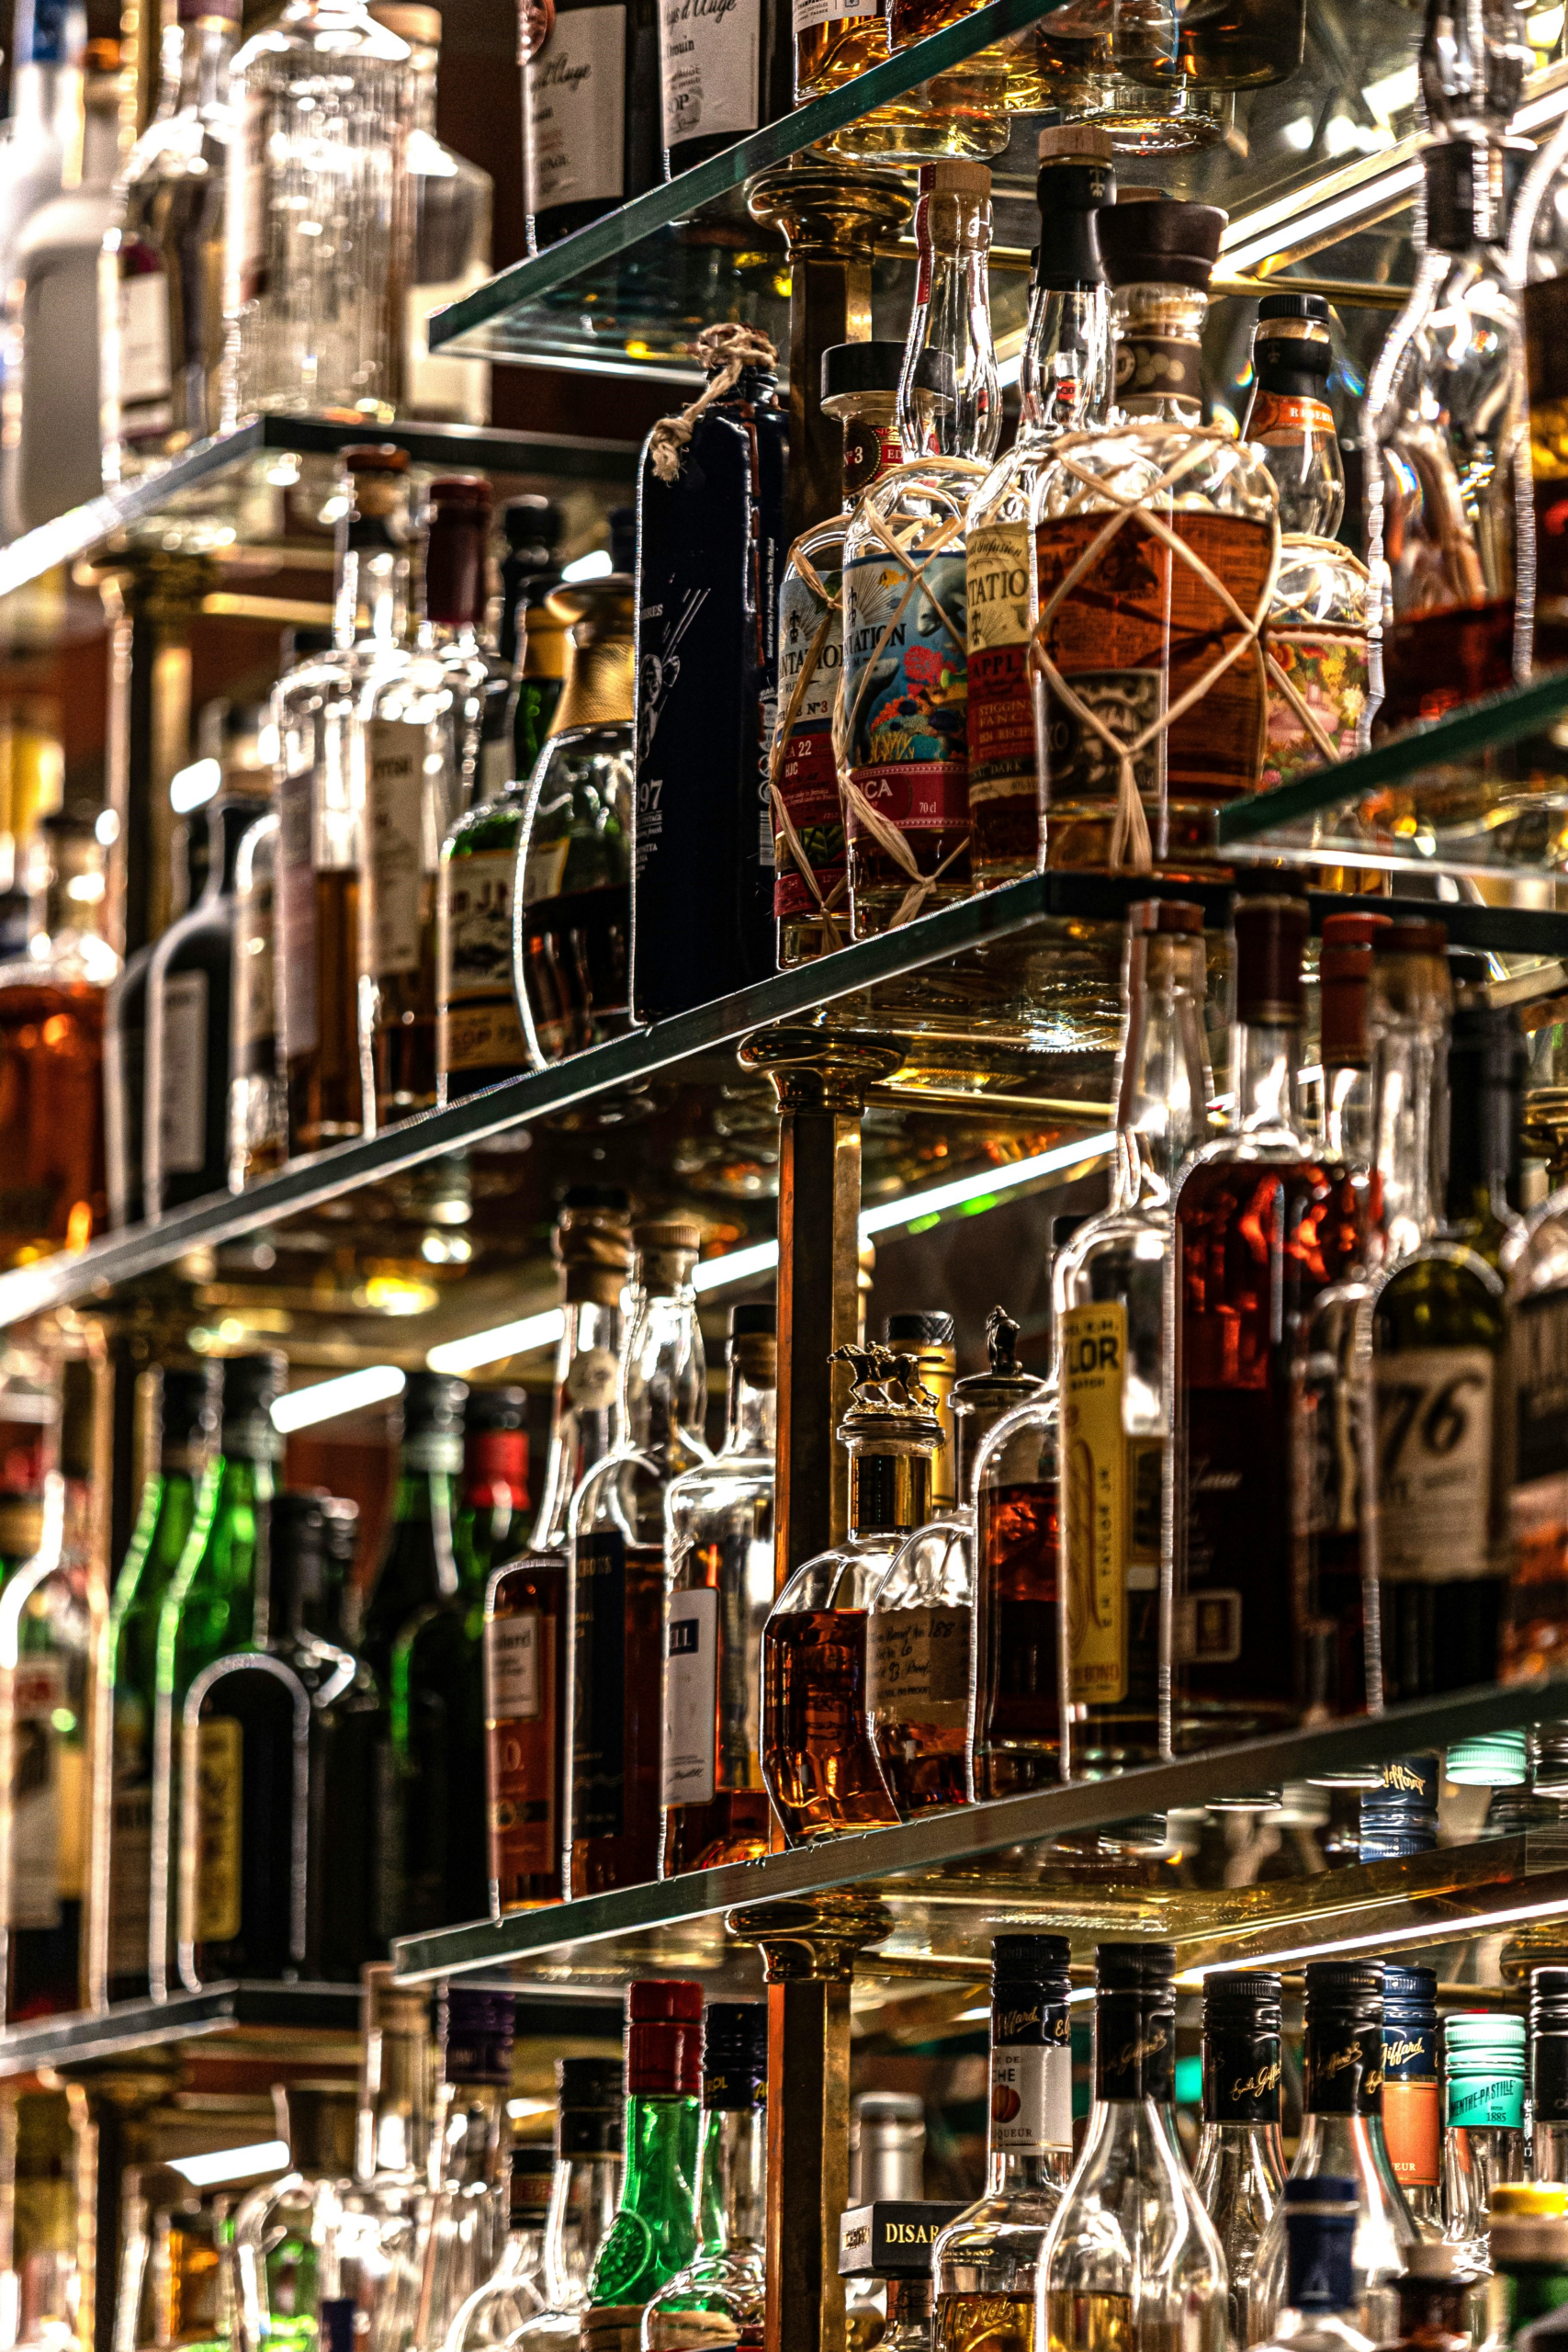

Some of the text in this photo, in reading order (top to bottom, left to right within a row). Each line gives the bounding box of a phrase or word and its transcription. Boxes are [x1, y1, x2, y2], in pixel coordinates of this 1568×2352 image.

[855, 446, 863, 464] 3
[968, 568, 1029, 608] TATIO
[845, 624, 905, 657] TATION
[798, 740, 812, 757] 22
[1066, 1336, 1120, 1374] LOR
[1006, 2055, 1021, 2064] DE
[1486, 2111, 1506, 2122] 1885
